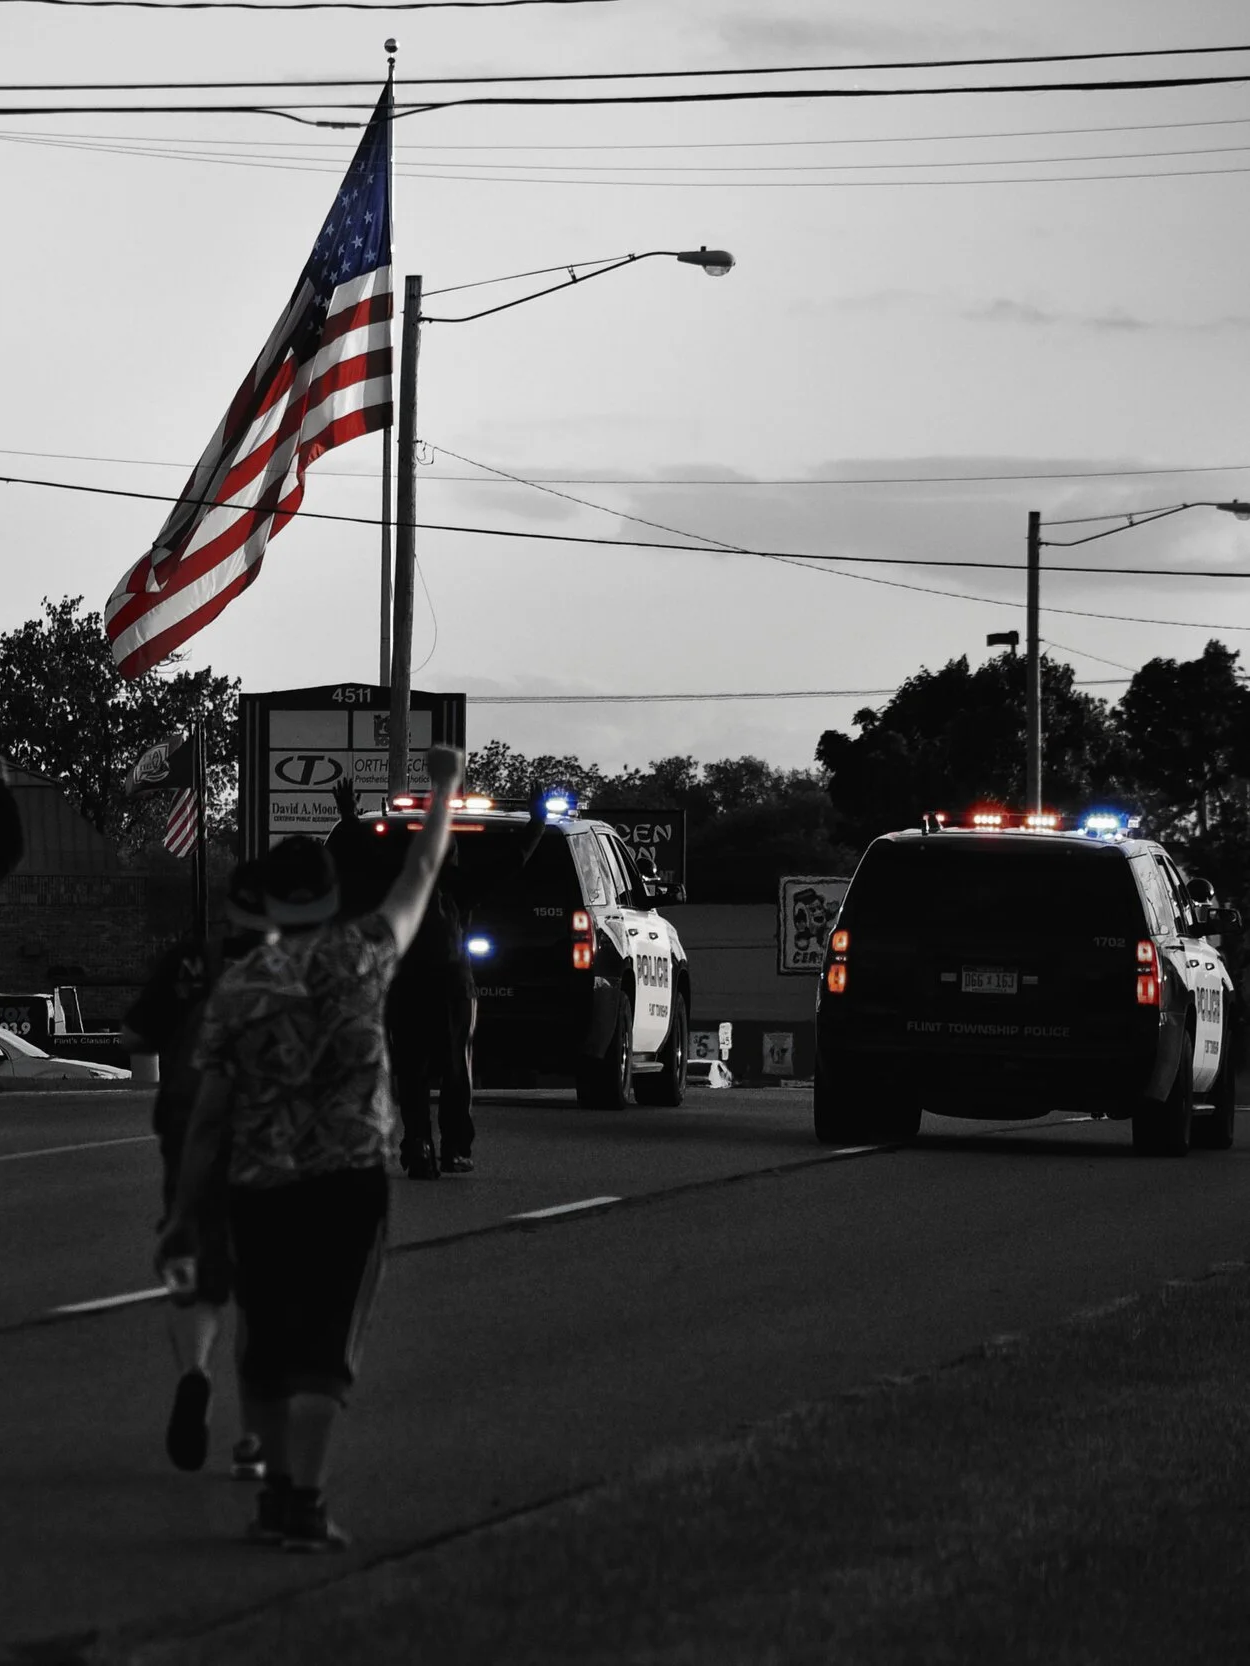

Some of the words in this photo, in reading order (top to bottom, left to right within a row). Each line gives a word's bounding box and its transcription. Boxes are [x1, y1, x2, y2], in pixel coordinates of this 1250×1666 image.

[332, 688, 372, 703] 4511
[354, 775, 389, 784] Prosthetic
[272, 802, 299, 815] David
[301, 802, 311, 815] A.
[533, 907, 564, 917] 1505
[1093, 936, 1126, 948] 1702
[636, 954, 669, 989] POLICE
[906, 1020, 943, 1033] FLINT
[948, 1022, 1019, 1036] TOWNSHIP
[1023, 1025, 1071, 1038] POLICE
[54, 1036, 78, 1045] Flint's
[80, 1036, 110, 1045] Classic
